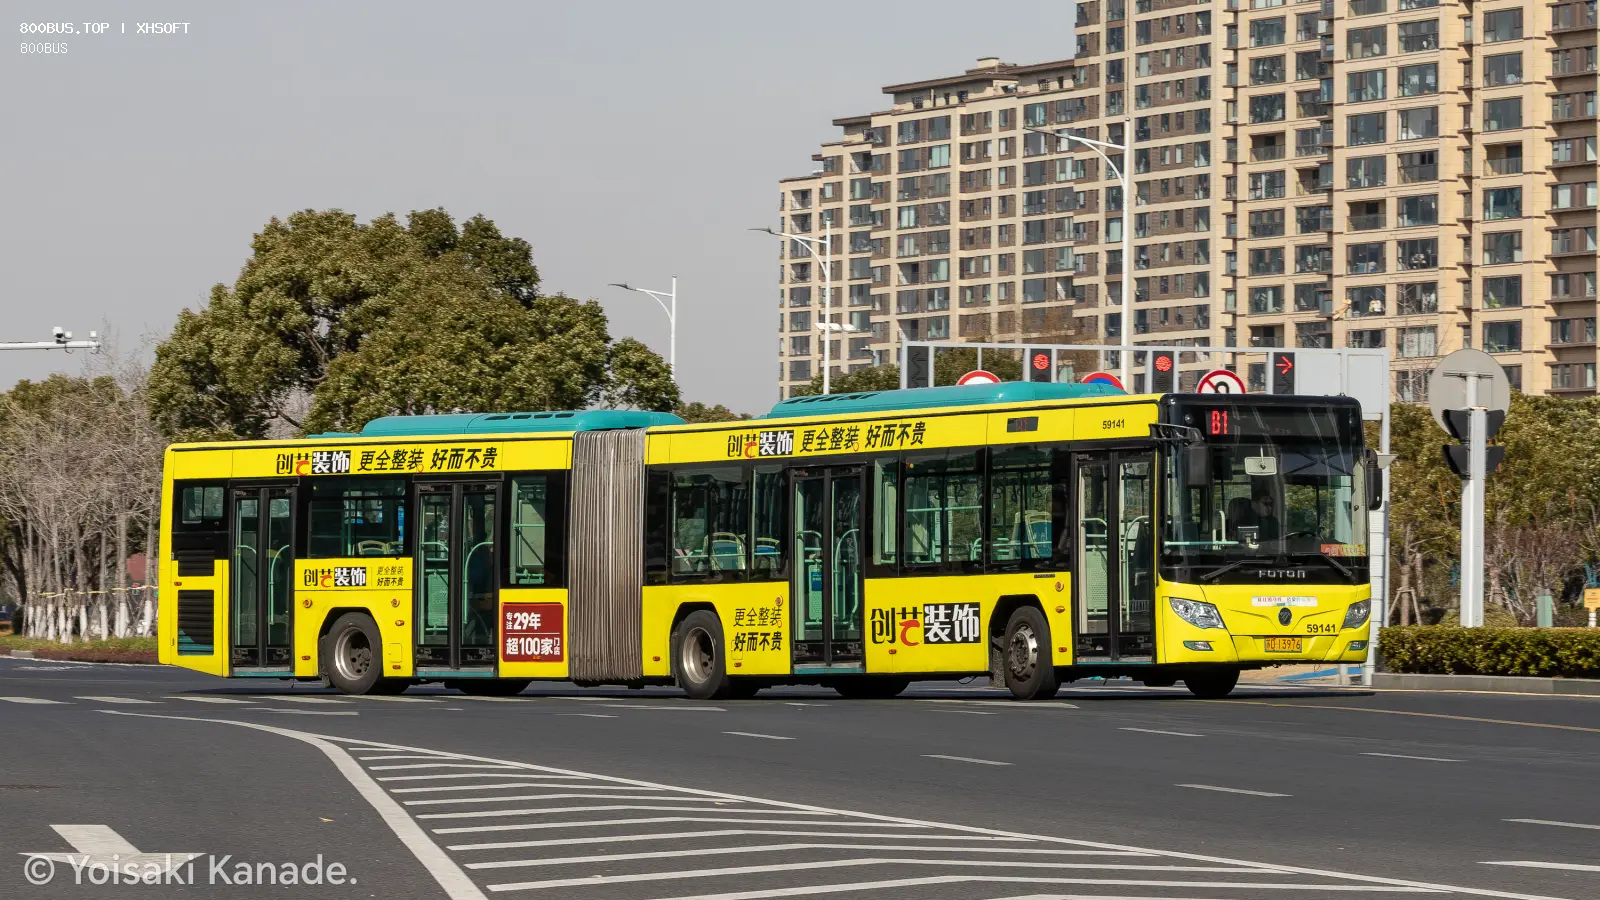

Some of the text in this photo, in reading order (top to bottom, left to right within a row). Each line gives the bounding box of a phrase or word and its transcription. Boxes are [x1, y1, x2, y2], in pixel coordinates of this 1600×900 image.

[1102, 418, 1126, 430] 59141
[1211, 410, 1228, 435] B1
[727, 420, 927, 459] 创艺装饰 更全整装 好而不贵
[276, 446, 499, 477] 创艺装饰 更全整装 好而不贵
[303, 566, 367, 588] 创艺装饰
[376, 565, 405, 576] 更全整装
[1258, 569, 1306, 579] FOTON
[376, 577, 405, 587] 好而不贵
[732, 606, 783, 628] 更全整装
[869, 602, 981, 647] 创艺装饰
[1306, 623, 1337, 634] 59141
[732, 630, 784, 653] 好而不贵
